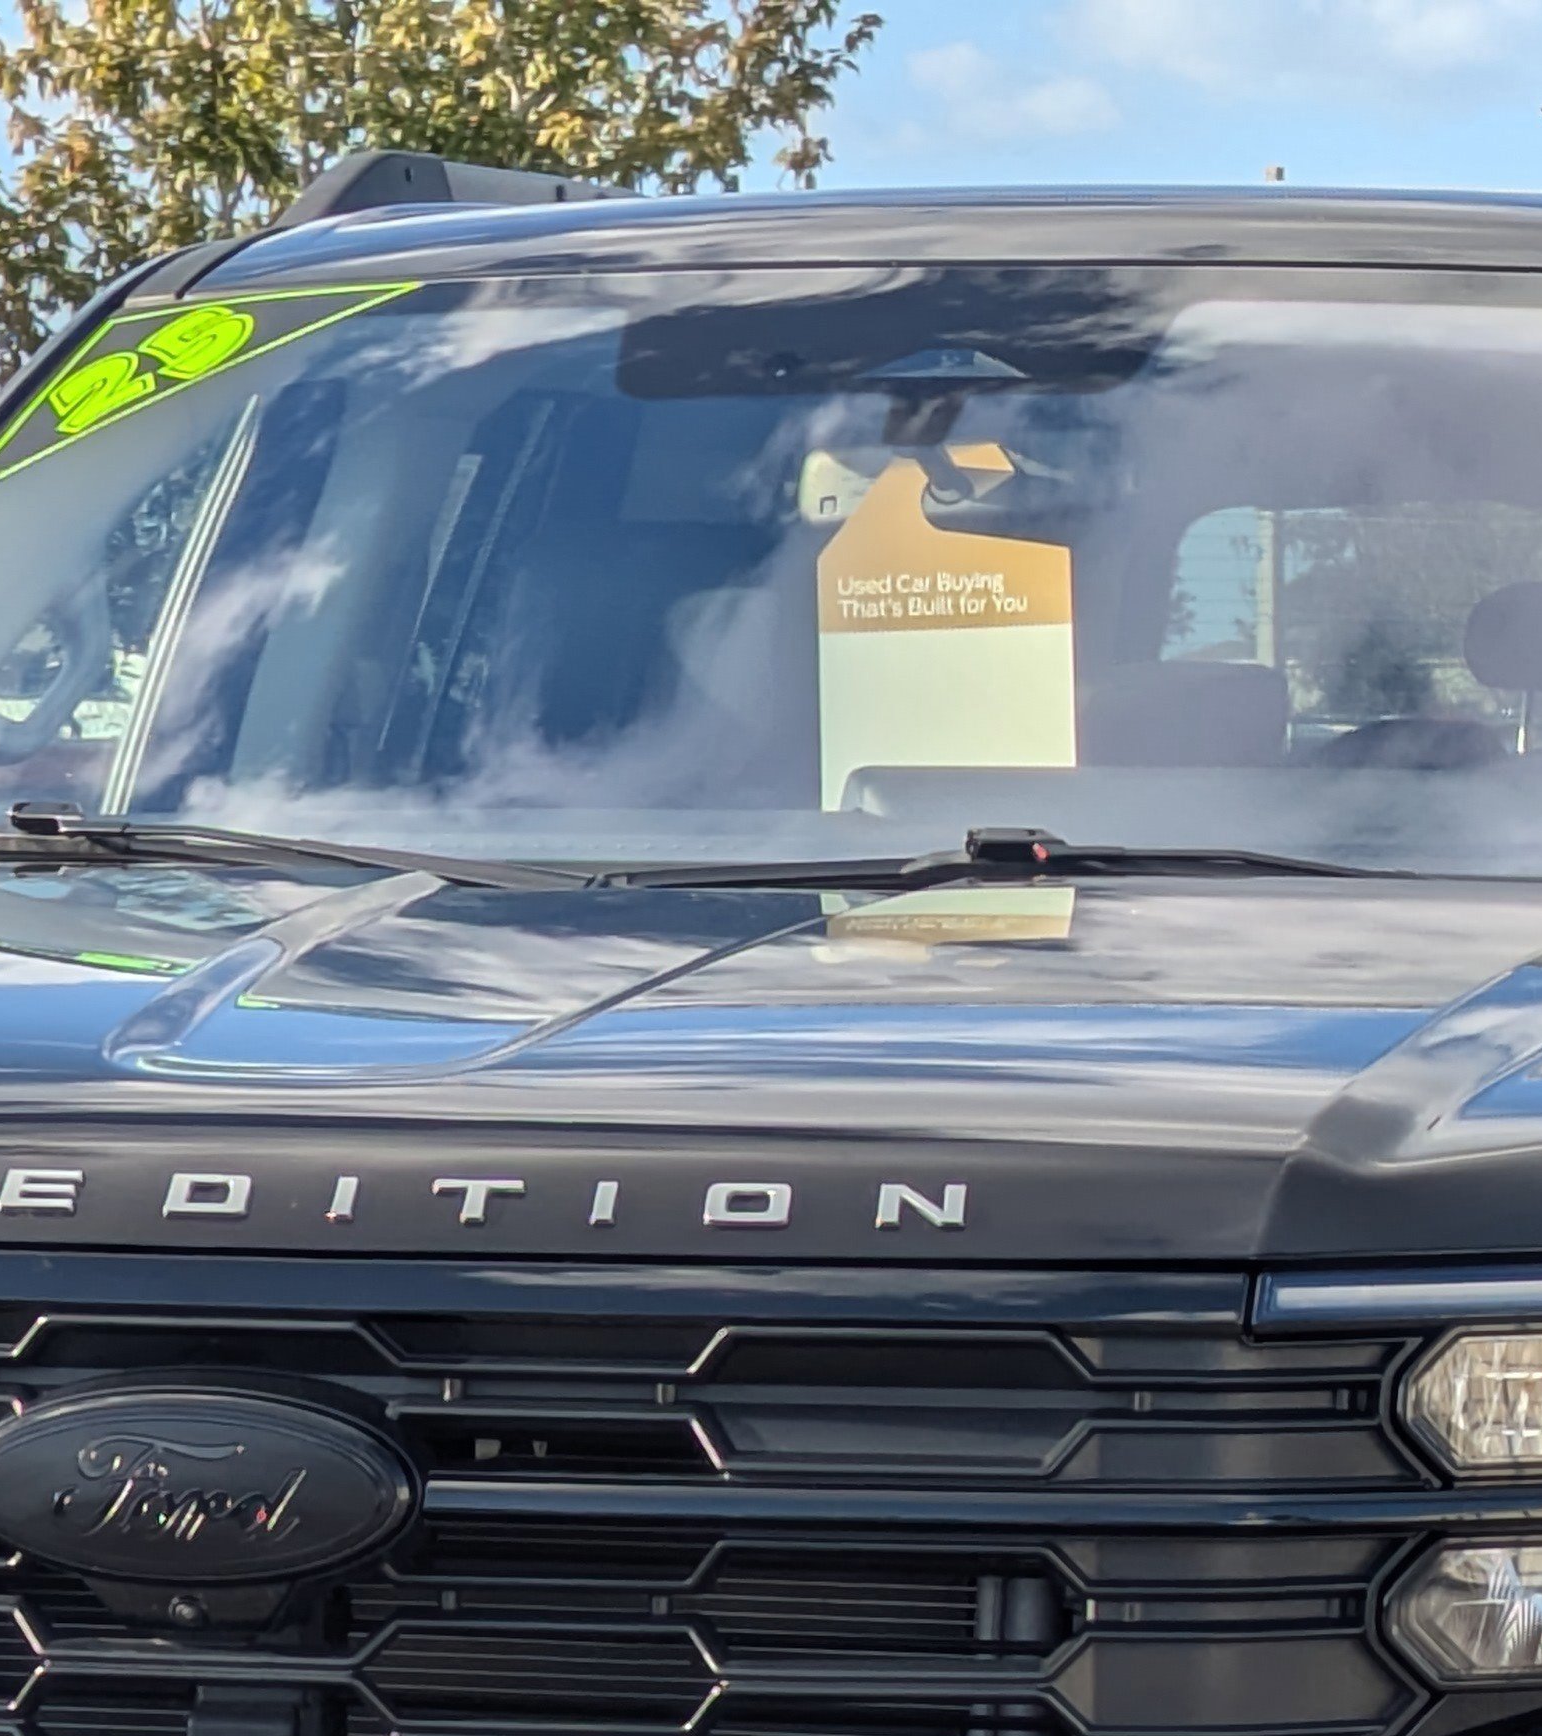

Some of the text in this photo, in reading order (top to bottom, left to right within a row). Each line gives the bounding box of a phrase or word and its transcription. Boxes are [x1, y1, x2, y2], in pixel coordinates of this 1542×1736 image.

[49, 306, 255, 435] 25
[837, 572, 1005, 597] Used Car Buying
[837, 595, 1028, 619] That's Built for You
[53, 1434, 308, 1543] Ford
